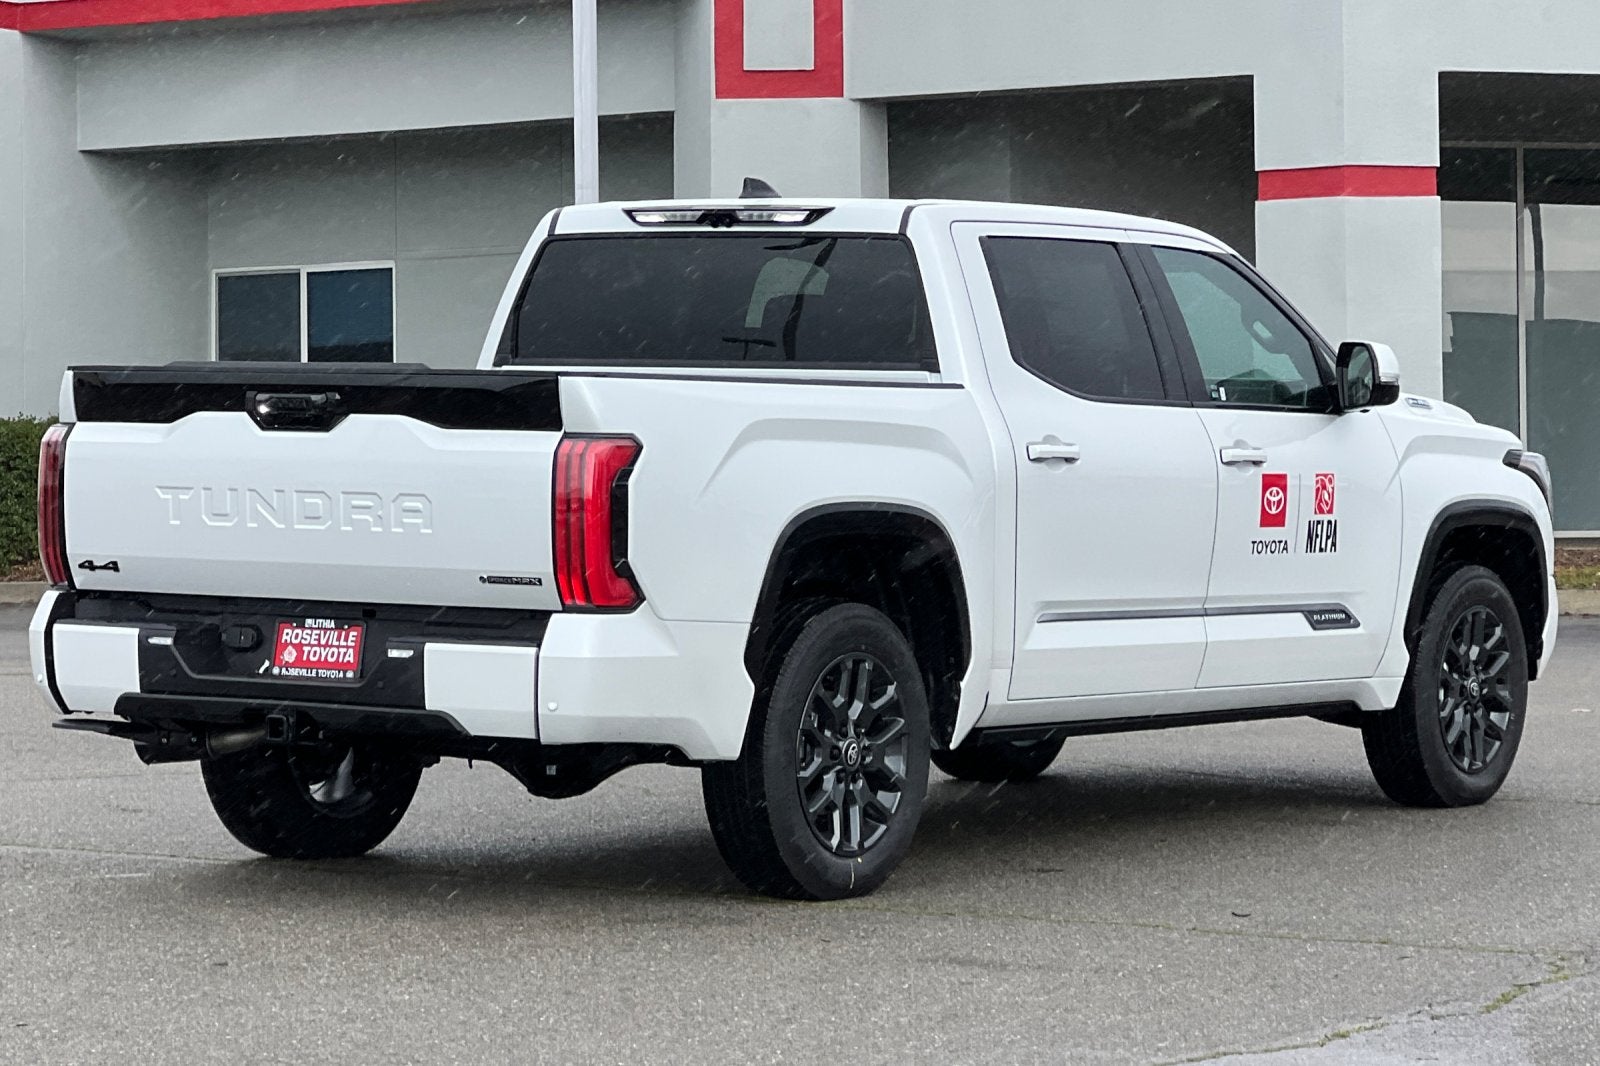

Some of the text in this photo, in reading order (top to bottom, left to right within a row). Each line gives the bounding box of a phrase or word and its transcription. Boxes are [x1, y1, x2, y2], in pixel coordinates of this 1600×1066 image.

[155, 485, 433, 534] TUNDRA
[1305, 519, 1338, 554] NFLPA
[1251, 540, 1289, 555] TOYOTA
[1313, 613, 1346, 621] PLATINUM
[281, 628, 358, 646] ROSEVILLE
[302, 646, 354, 663] TOYOTA
[318, 669, 344, 679] TOYOTA
